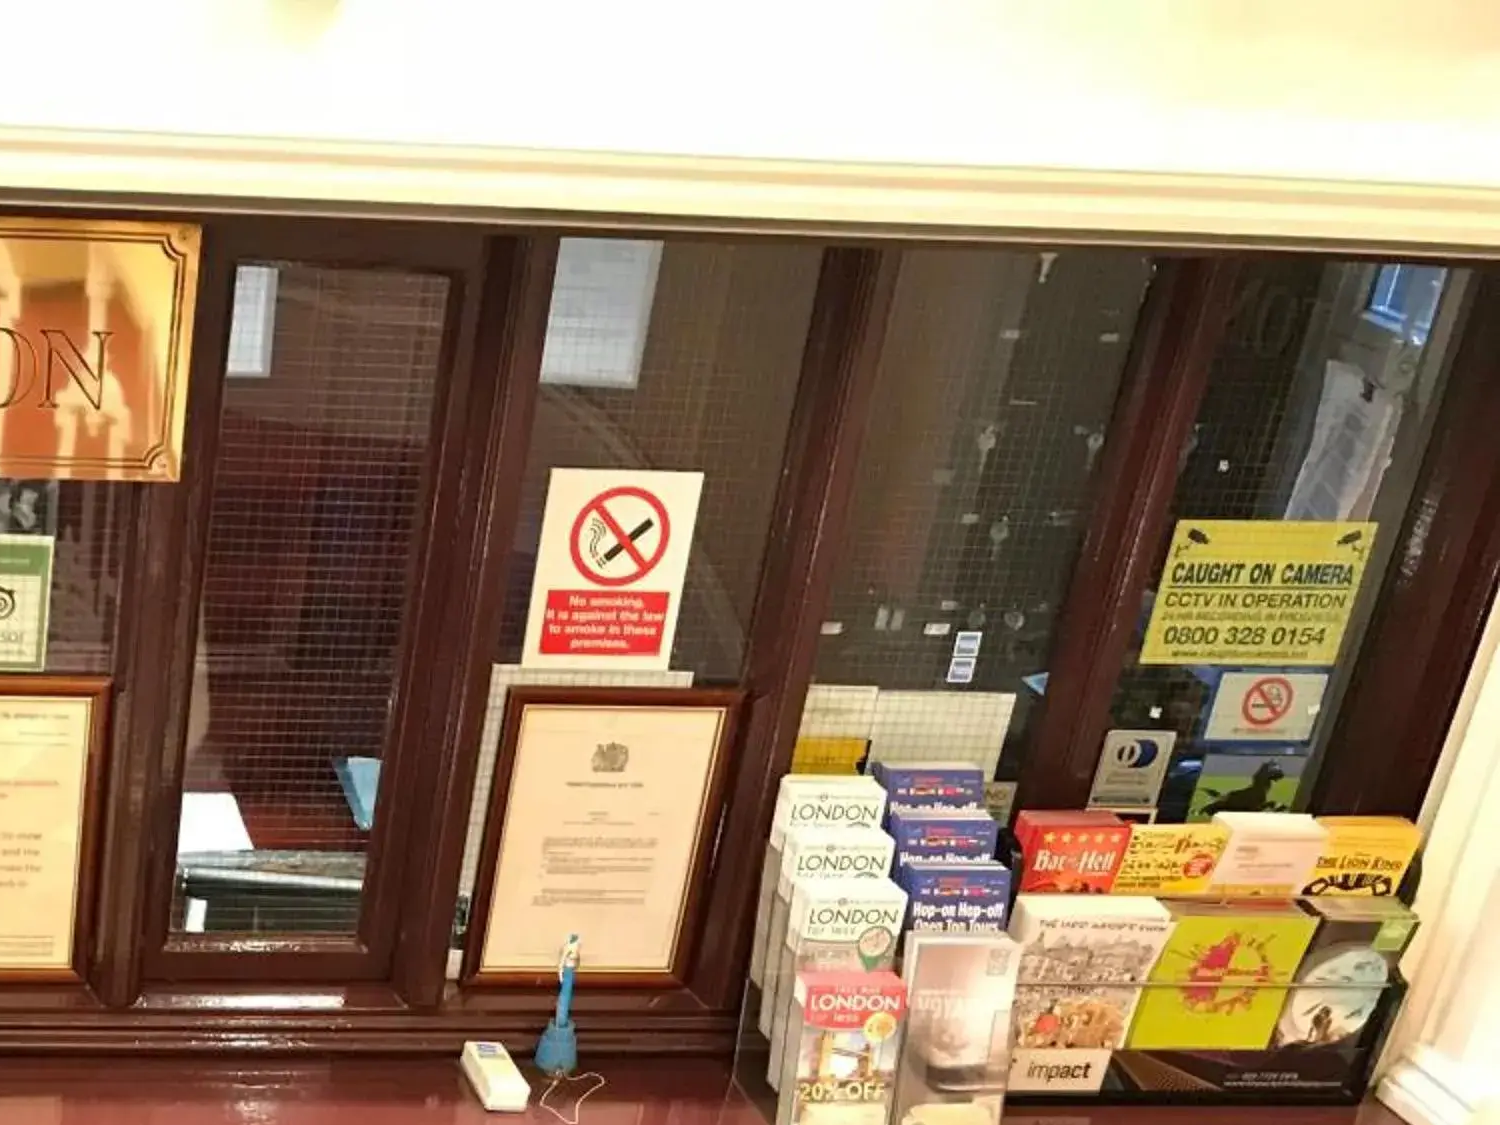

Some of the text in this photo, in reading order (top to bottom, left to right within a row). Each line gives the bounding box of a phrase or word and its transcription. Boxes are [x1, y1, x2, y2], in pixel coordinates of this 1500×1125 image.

[1170, 562, 1355, 586] CAUGHT ON CAMERA
[569, 595, 587, 607] No
[1164, 591, 1348, 609] CCTV IN OPERATION
[571, 610, 618, 622] against
[619, 610, 640, 622] the
[642, 610, 665, 621] law
[548, 623, 657, 636] to smoke in these
[1163, 625, 1327, 646] 0800 328 0154
[790, 803, 880, 821] LONDON
[797, 854, 888, 872] LONDON
[1032, 849, 1066, 872] Bat
[1076, 850, 1117, 874] Hell
[808, 908, 899, 926] LONDON
[912, 901, 1005, 921] Hop-on Hop-off
[810, 993, 901, 1013] LONDON
[1027, 1059, 1093, 1082] impact
[800, 1083, 887, 1101] 20% OFF
